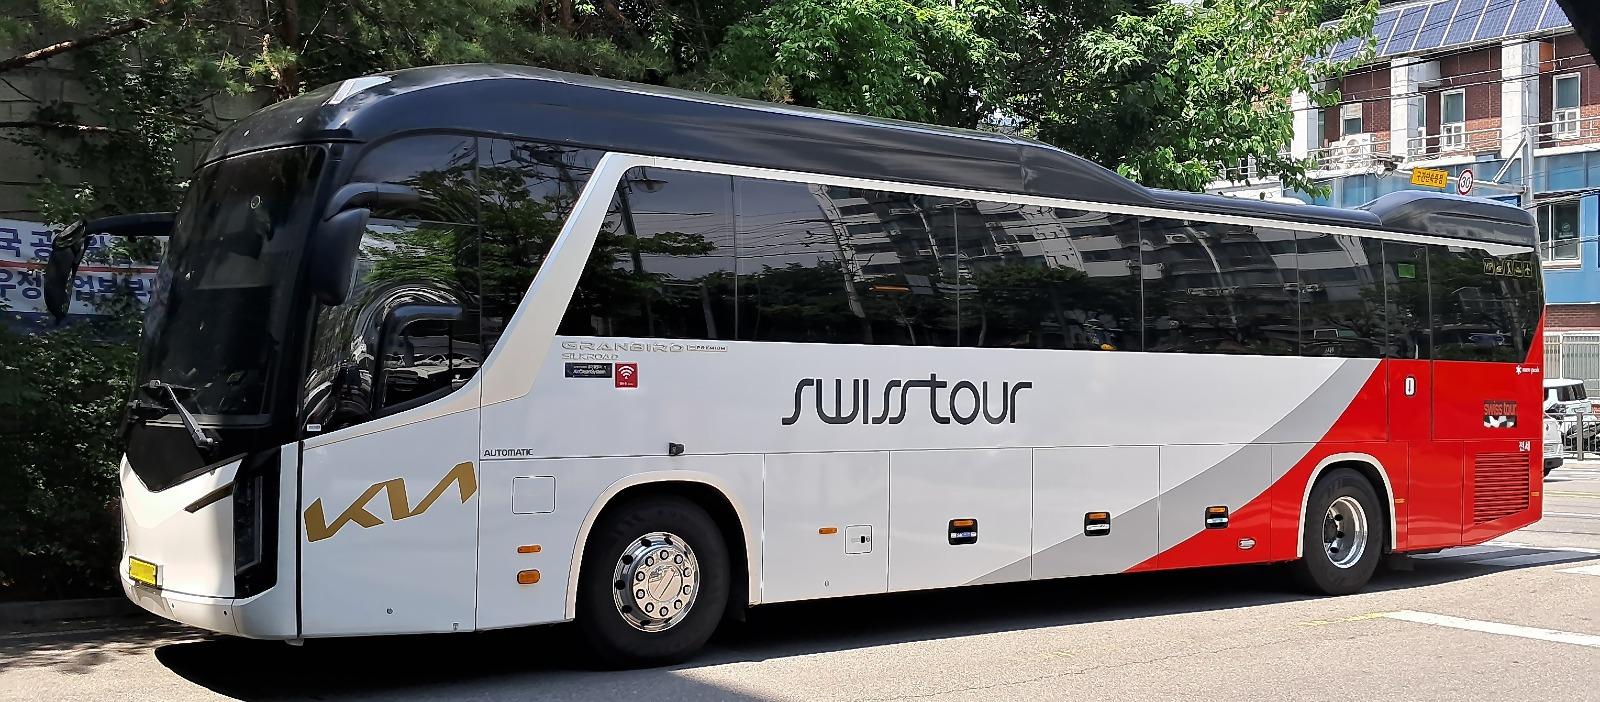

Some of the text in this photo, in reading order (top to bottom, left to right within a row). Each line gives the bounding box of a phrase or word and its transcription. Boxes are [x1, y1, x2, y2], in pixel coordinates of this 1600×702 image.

[1461, 176, 1470, 188] 30
[561, 341, 684, 352] GRANBIRD
[562, 352, 619, 360] SILKROAD
[1484, 401, 1517, 415] swiss tour
[1519, 441, 1531, 452] 전세
[484, 448, 533, 457] AUTOMATIC
